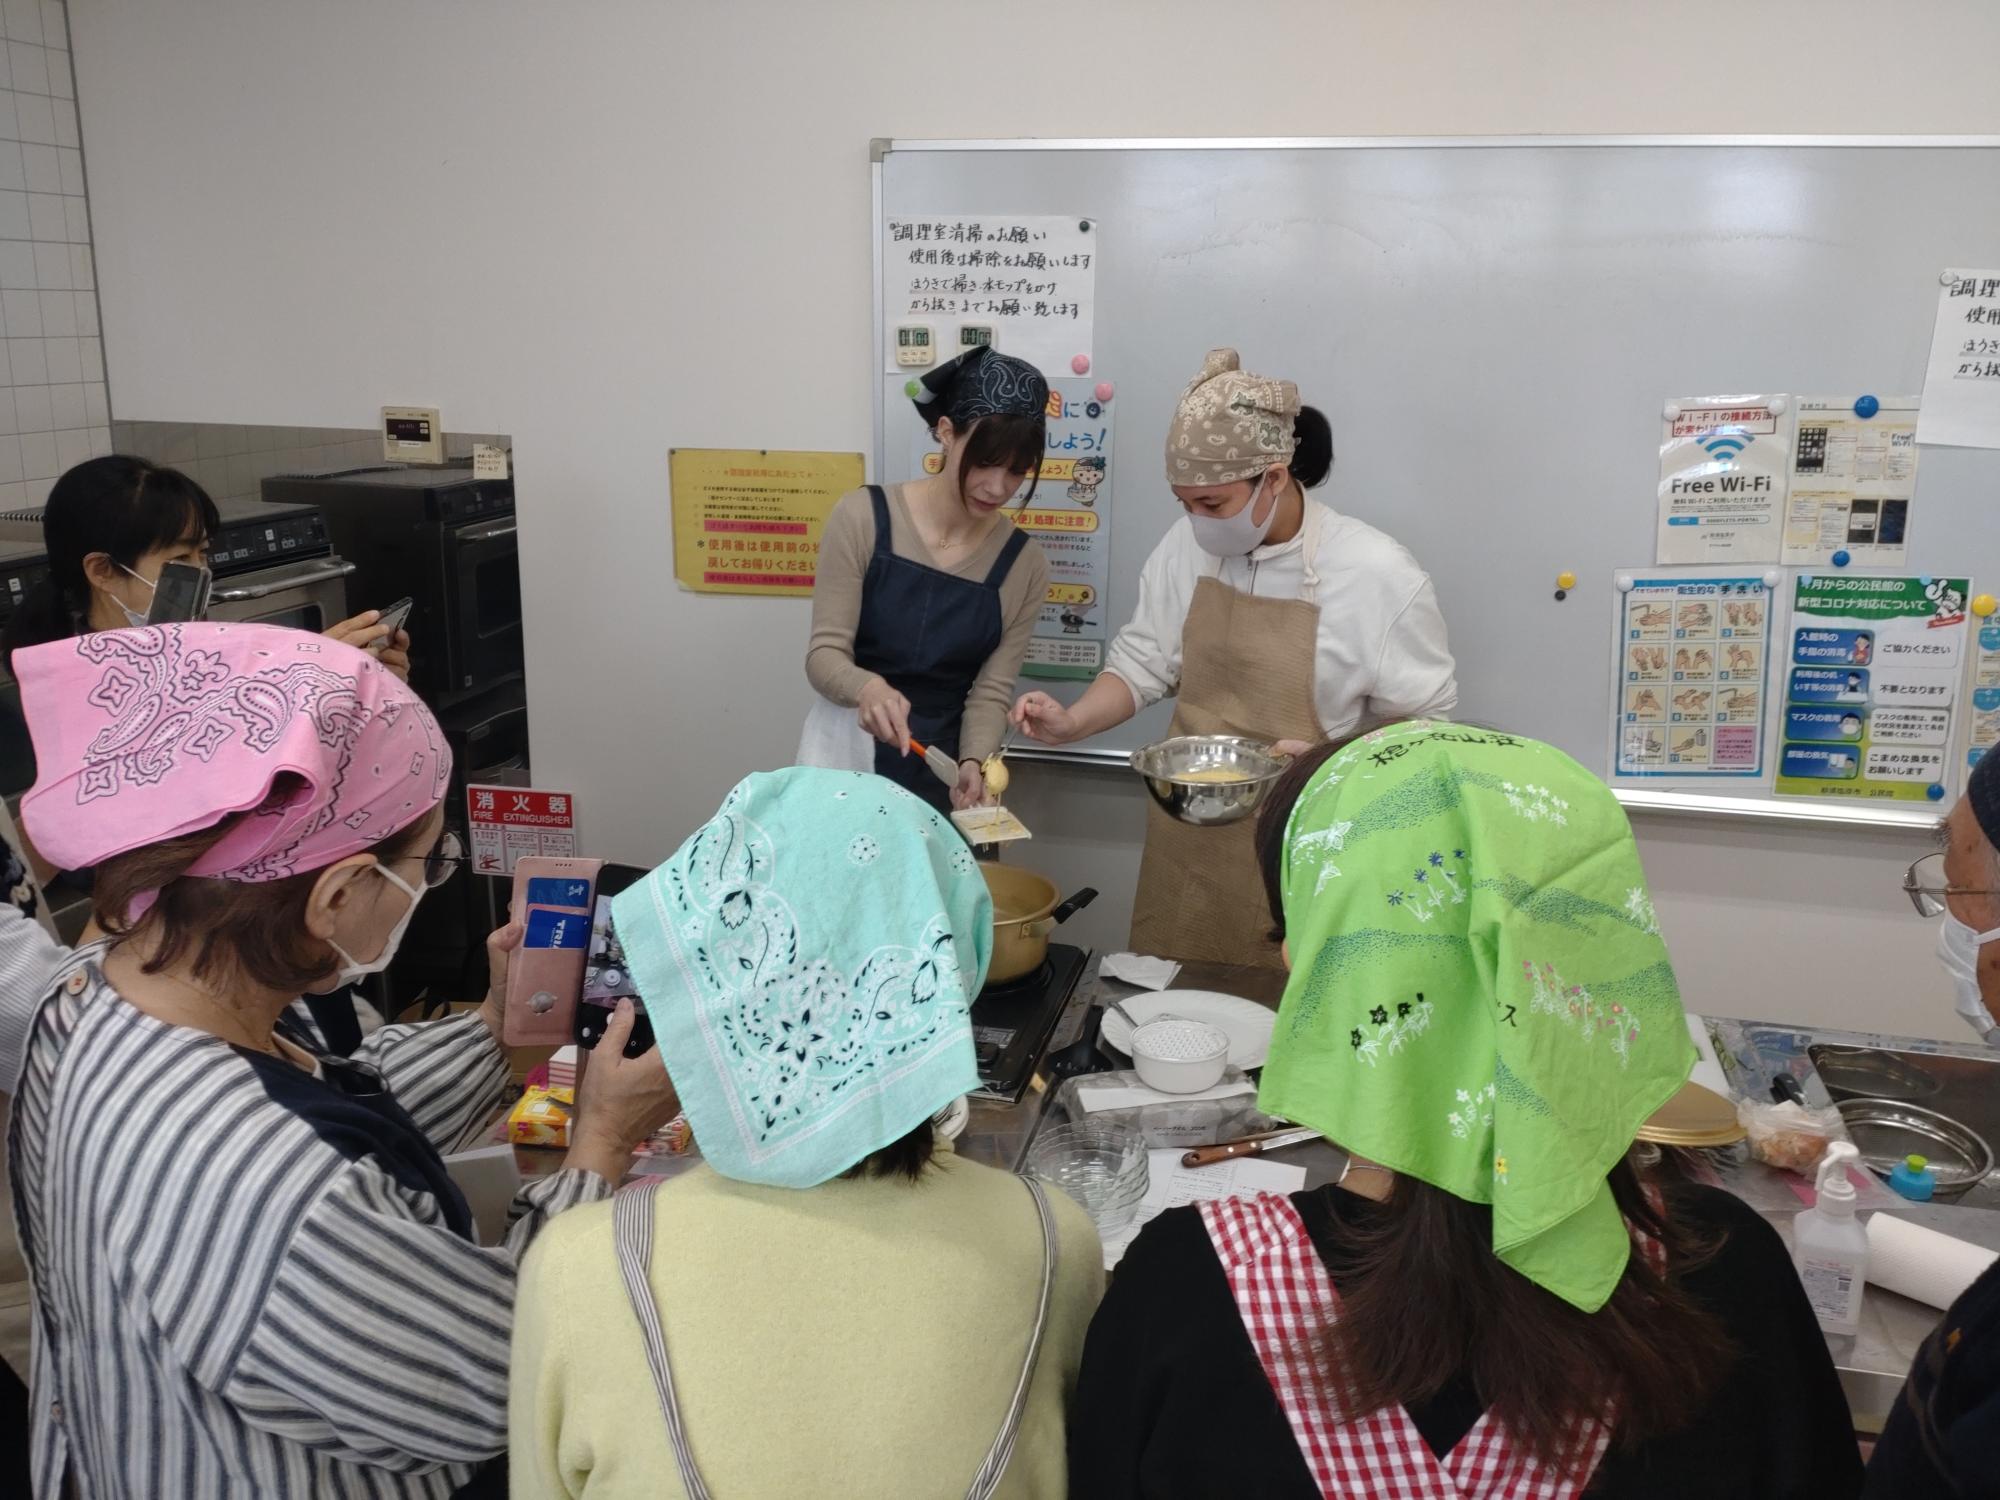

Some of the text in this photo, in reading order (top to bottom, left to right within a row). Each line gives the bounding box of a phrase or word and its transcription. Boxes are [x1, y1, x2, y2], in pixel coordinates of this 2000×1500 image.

[908, 248, 1092, 270] 使用後は掃除をお願いします
[1671, 475, 1772, 493] Free Wi-Fi
[1797, 596, 1928, 611] 新型コロナ対応について
[1883, 644, 1951, 654] ご協力ください
[1879, 684, 1947, 695] 不要となります
[1867, 766, 1925, 776] お願いします
[476, 791, 568, 814] 消火器
[473, 810, 571, 825] FIRE EXTINGUISHER
